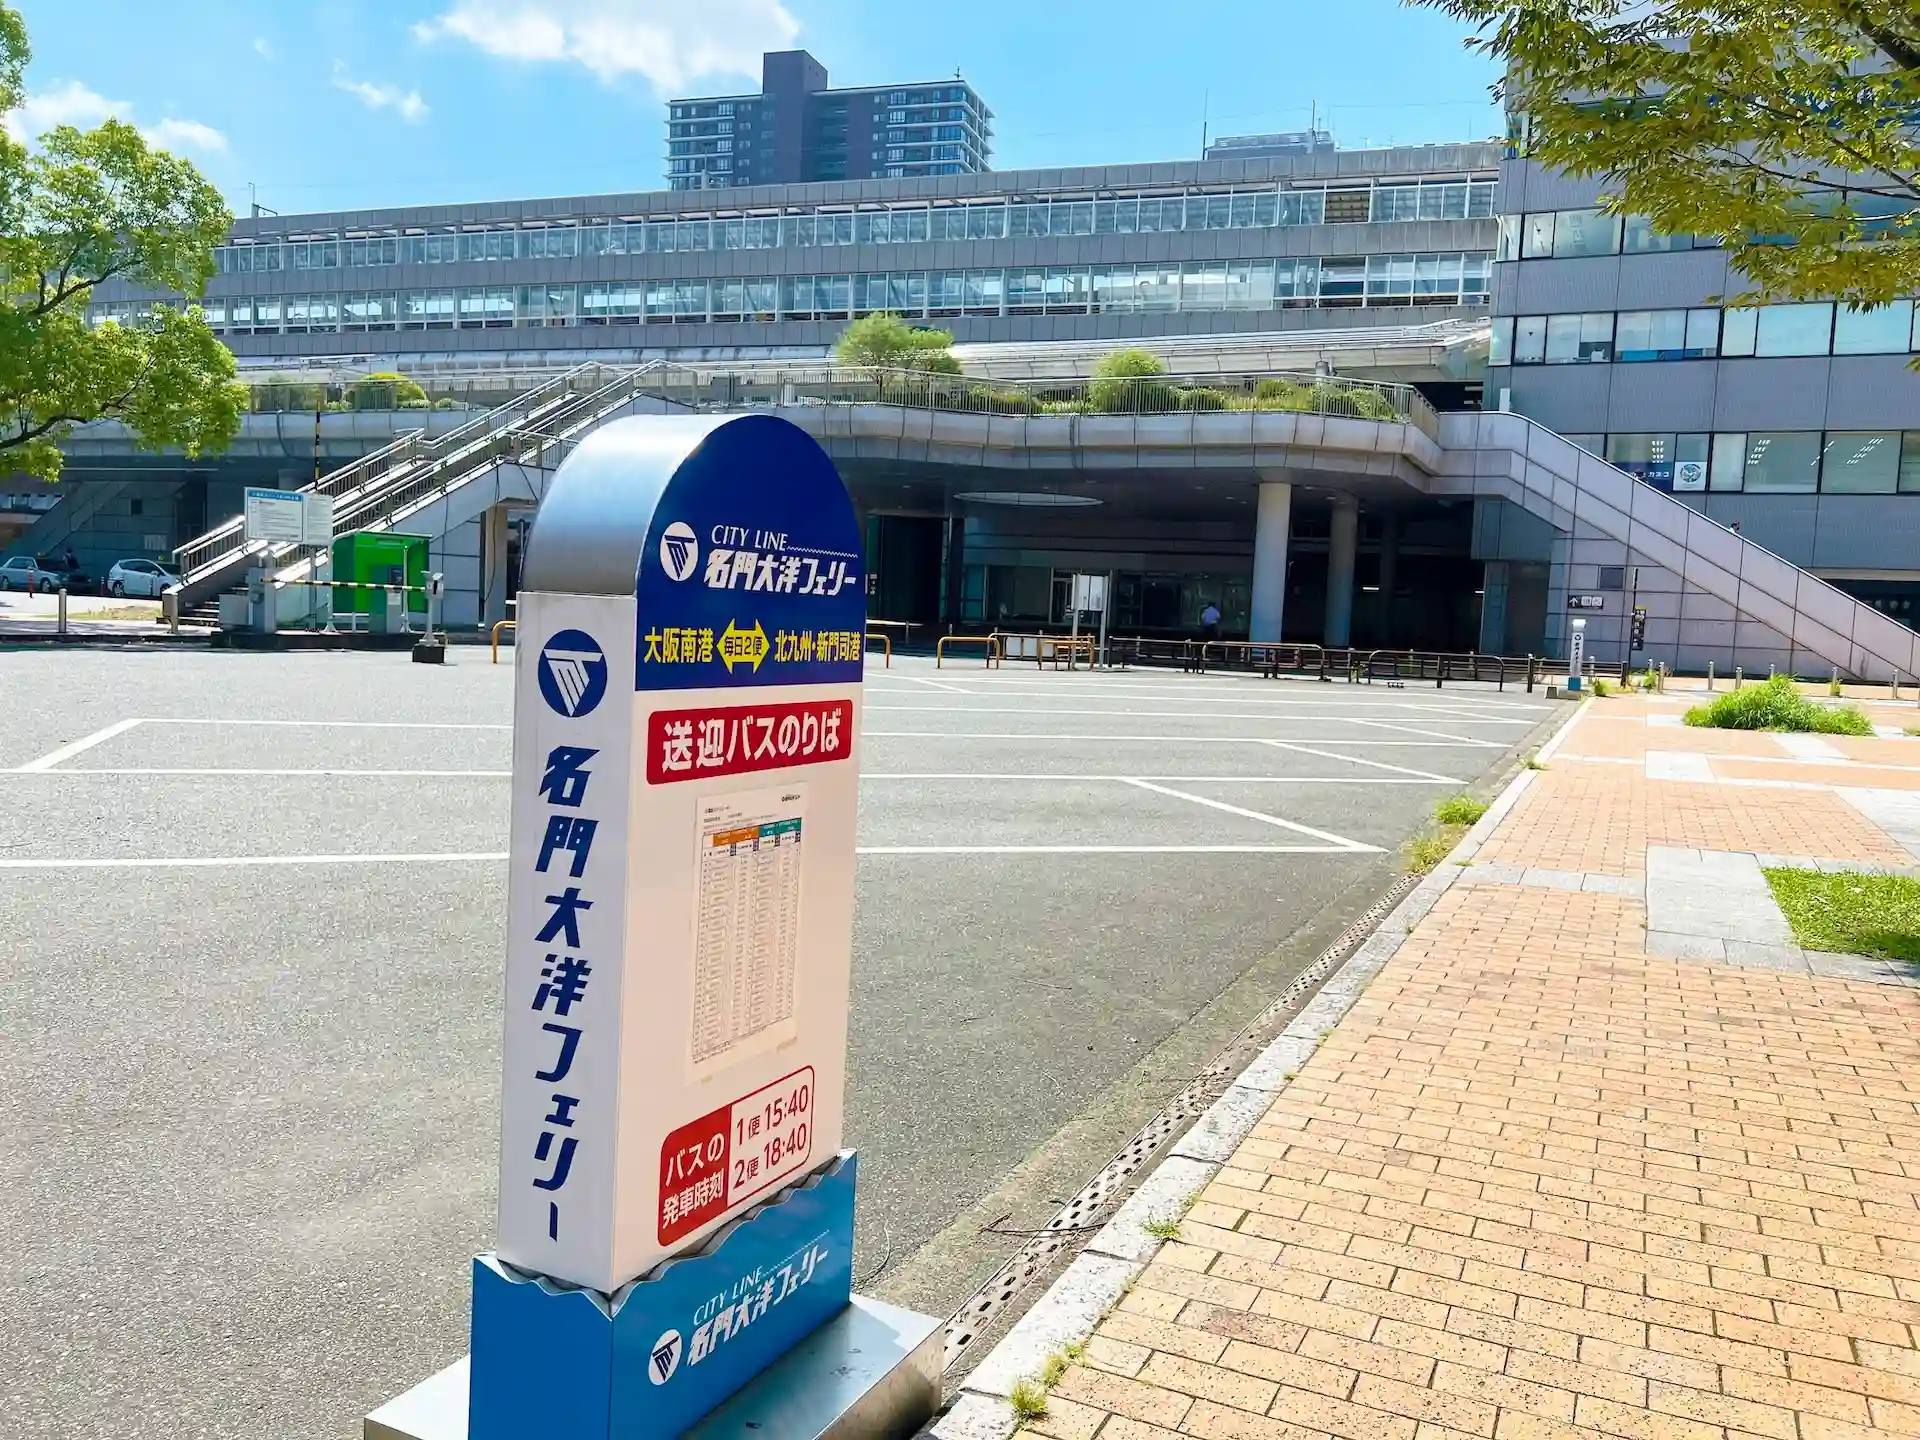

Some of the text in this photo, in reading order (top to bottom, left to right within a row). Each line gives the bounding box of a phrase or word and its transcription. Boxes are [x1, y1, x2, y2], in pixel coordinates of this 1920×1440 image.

[711, 524, 788, 551] CITY LINE
[704, 548, 856, 596] 名門大洋フェリー
[644, 626, 714, 663] 大阪南港
[724, 636, 762, 657] 毎日2便
[661, 708, 842, 774] 送迎バスのりば
[532, 745, 600, 1242] 名門大洋フェリー
[736, 1084, 808, 1146] 1便 15:40
[665, 1133, 724, 1187] バスの
[733, 1123, 806, 1189] 2便 18:40
[662, 1168, 724, 1229] 発車時刻
[687, 1244, 829, 1367] 名門大洋フェリー
[693, 1265, 763, 1326] CITY LINE
